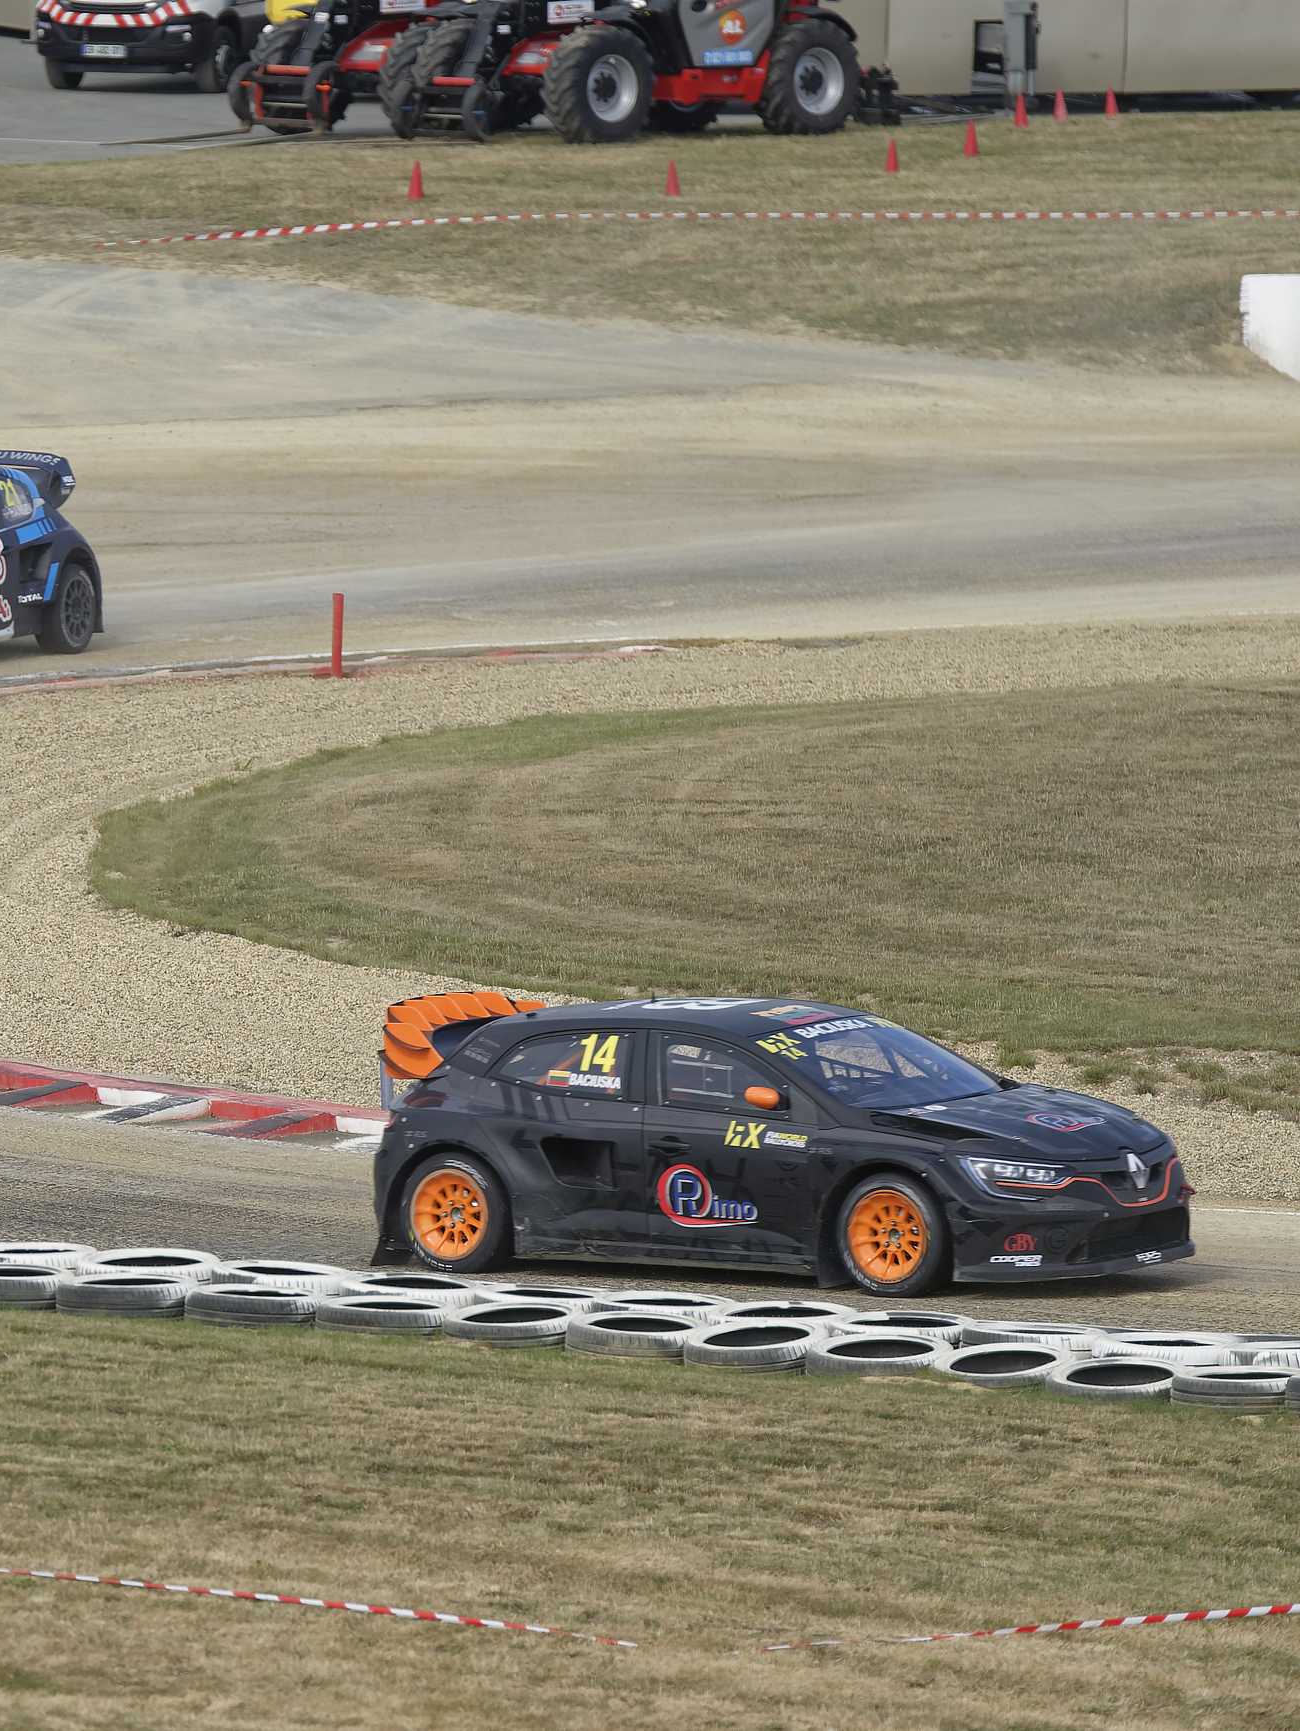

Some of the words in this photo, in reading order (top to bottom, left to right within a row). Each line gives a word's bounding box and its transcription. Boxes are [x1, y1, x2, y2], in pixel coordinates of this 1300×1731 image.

[8, 452, 61, 466] WINGS
[793, 1019, 874, 1039] BACIUSKA
[579, 1033, 620, 1073] 14
[569, 1073, 621, 1089] BACIUSKA
[990, 1254, 1043, 1263] COOPER
